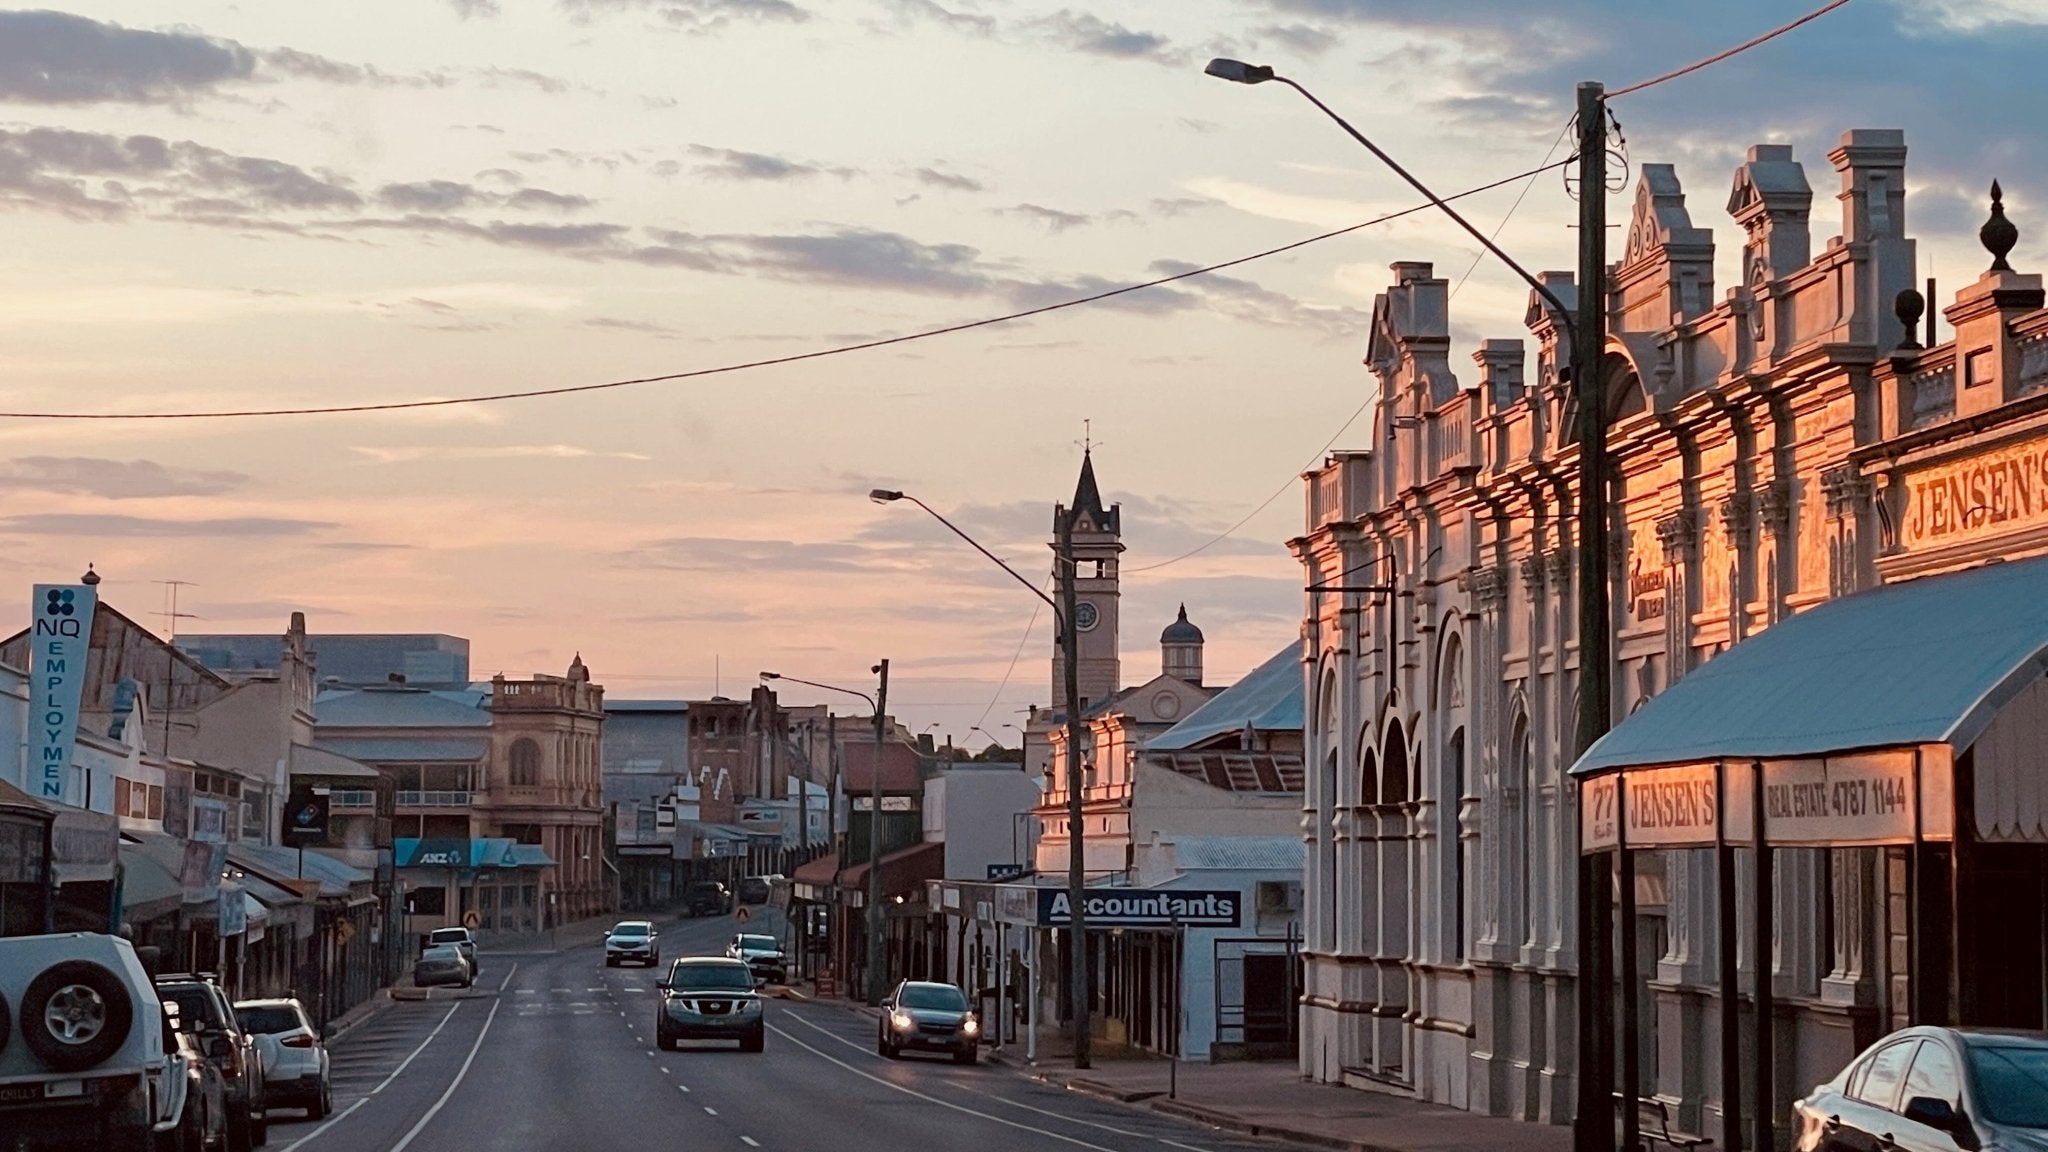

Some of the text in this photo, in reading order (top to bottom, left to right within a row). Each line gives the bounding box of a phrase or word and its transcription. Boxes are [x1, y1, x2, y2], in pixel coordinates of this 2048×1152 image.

[37, 619, 79, 638] NQ
[43, 641, 65, 796] EMPLOYMEN
[1593, 784, 1614, 821] 77
[1631, 781, 1714, 829] JENSEN'S
[1767, 777, 1906, 818] REAL ESTATE 4787 1144
[420, 852, 448, 864] ANZ
[1050, 892, 1233, 916] Acountants
